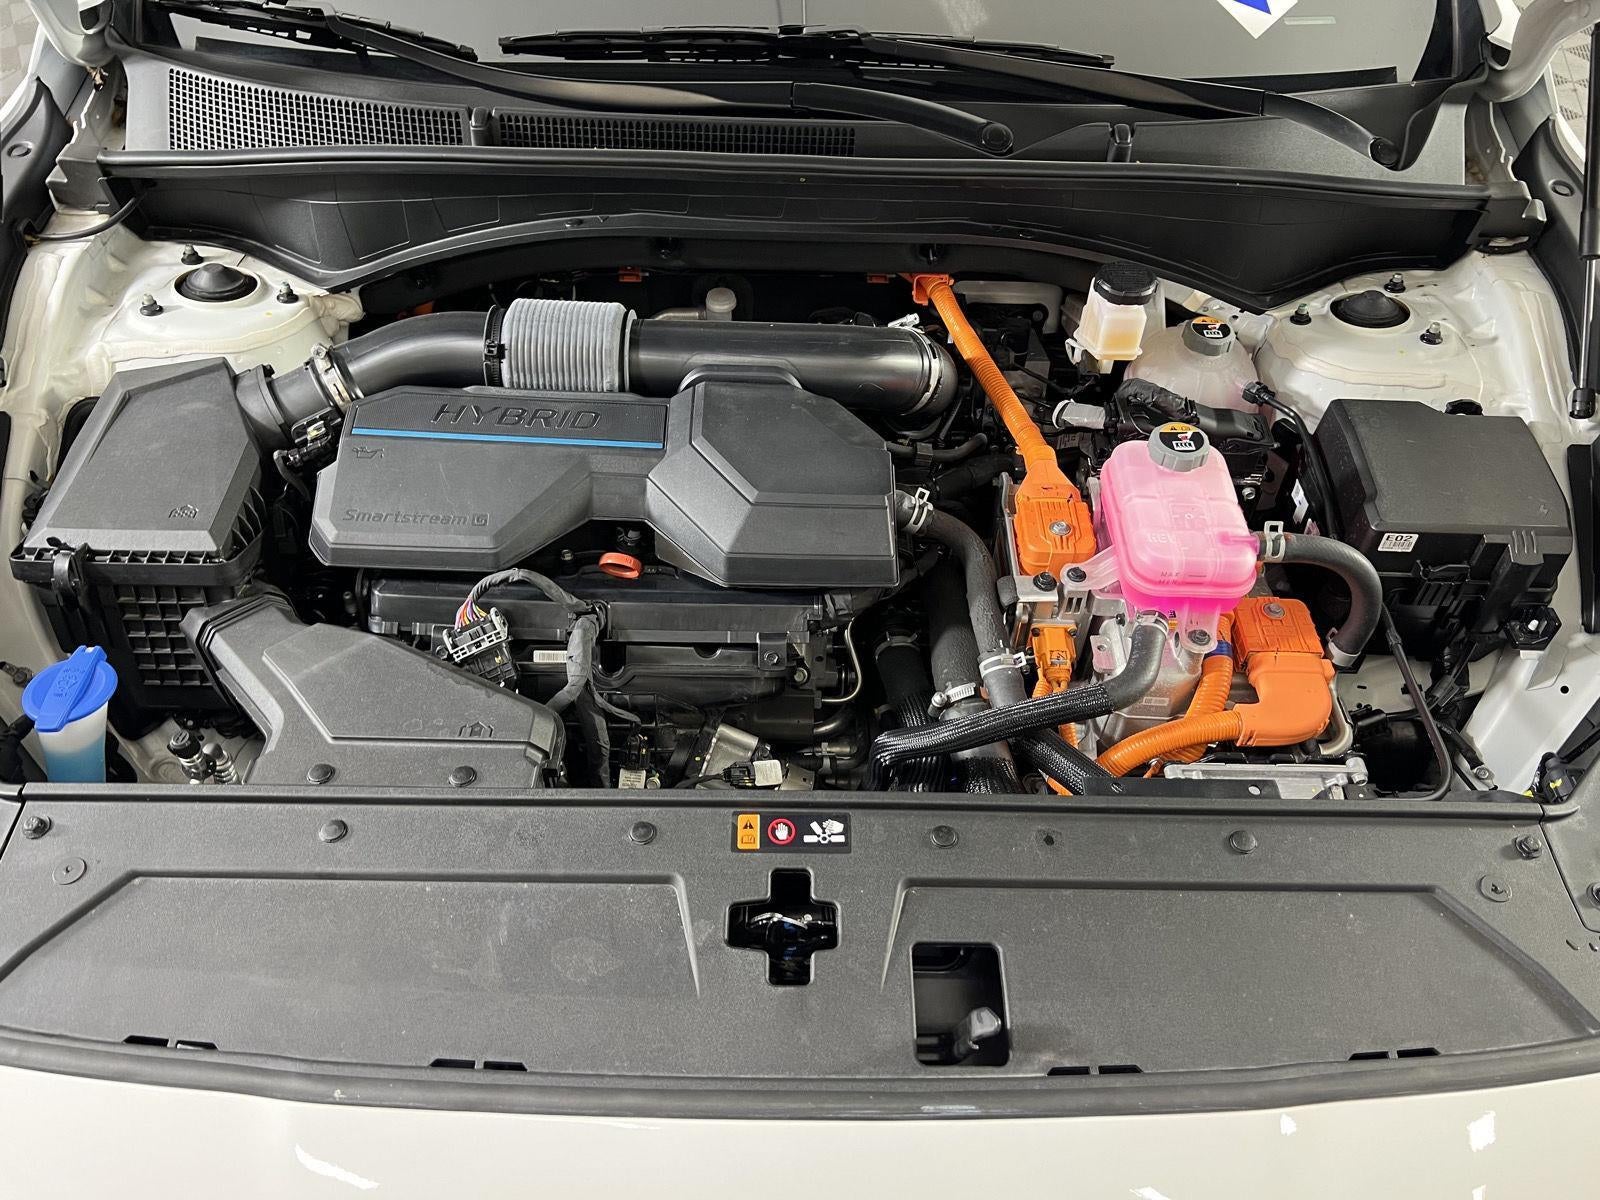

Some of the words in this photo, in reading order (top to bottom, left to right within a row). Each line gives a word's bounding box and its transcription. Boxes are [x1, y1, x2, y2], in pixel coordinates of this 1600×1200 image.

[430, 403, 601, 429] HYBRID
[342, 509, 468, 526] Smartstream
[1385, 534, 1413, 542] E02
